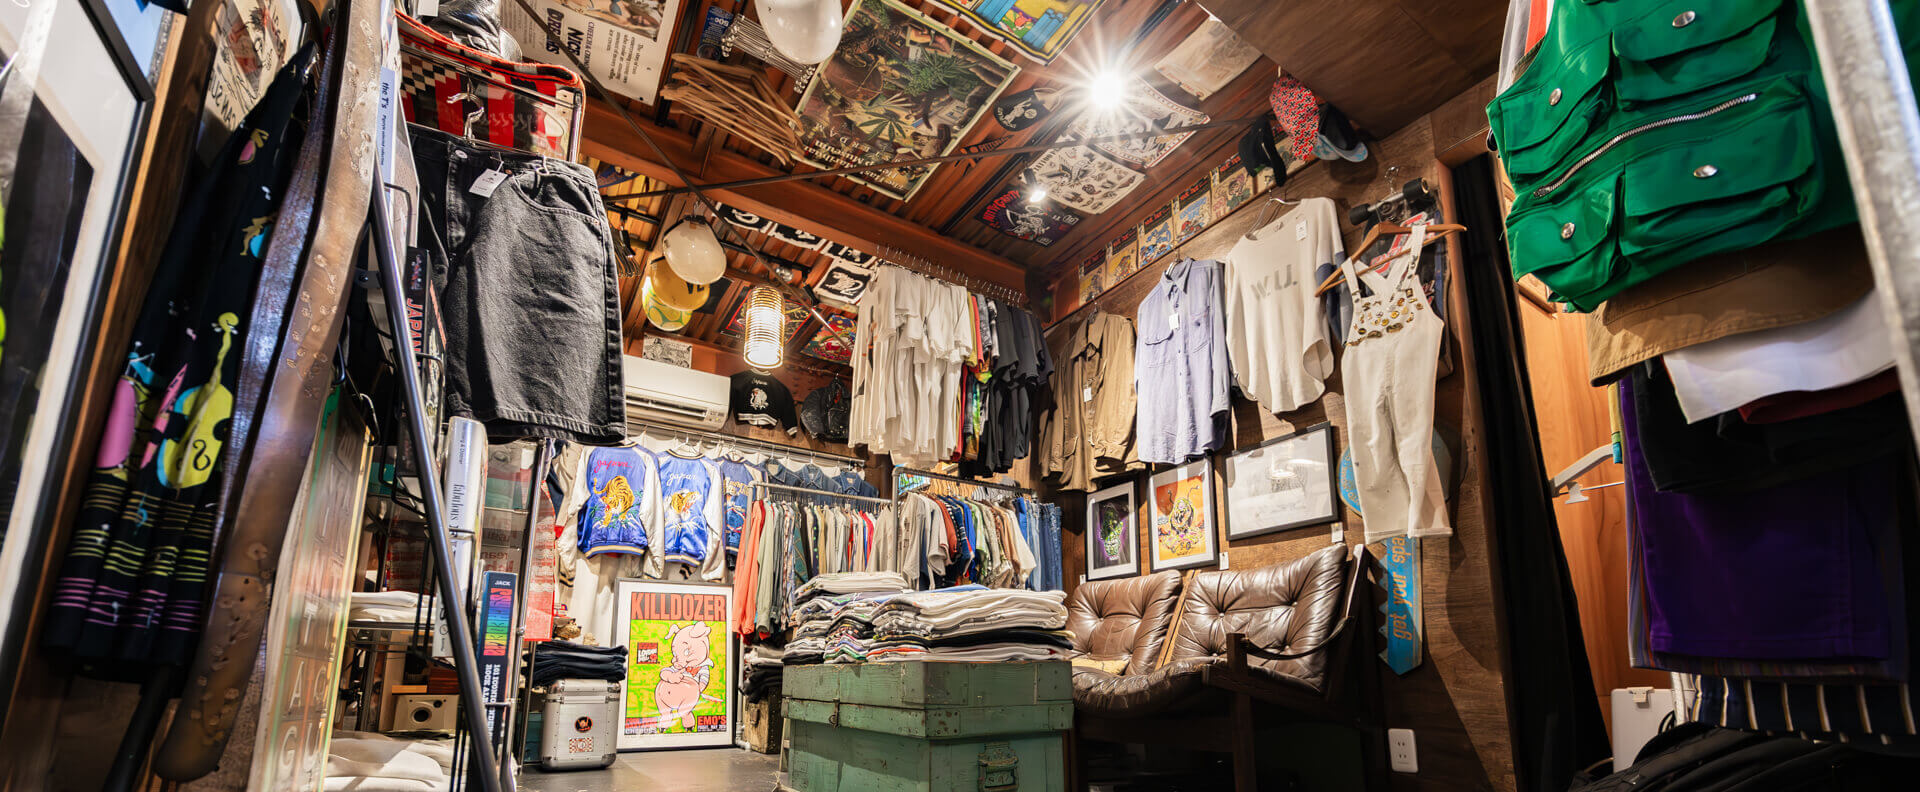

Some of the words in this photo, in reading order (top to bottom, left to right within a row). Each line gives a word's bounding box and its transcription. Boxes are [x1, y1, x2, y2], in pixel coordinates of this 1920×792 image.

[568, 27, 584, 56] NICE
[814, 139, 864, 163] Museum
[450, 484, 465, 521] fabulous
[1392, 535, 1411, 563] spa
[1392, 572, 1413, 607] your
[631, 592, 726, 621] KILLDOZER
[1390, 613, 1412, 640] get
[484, 664, 492, 685] ROCK
[697, 715, 727, 725] EMO'S
